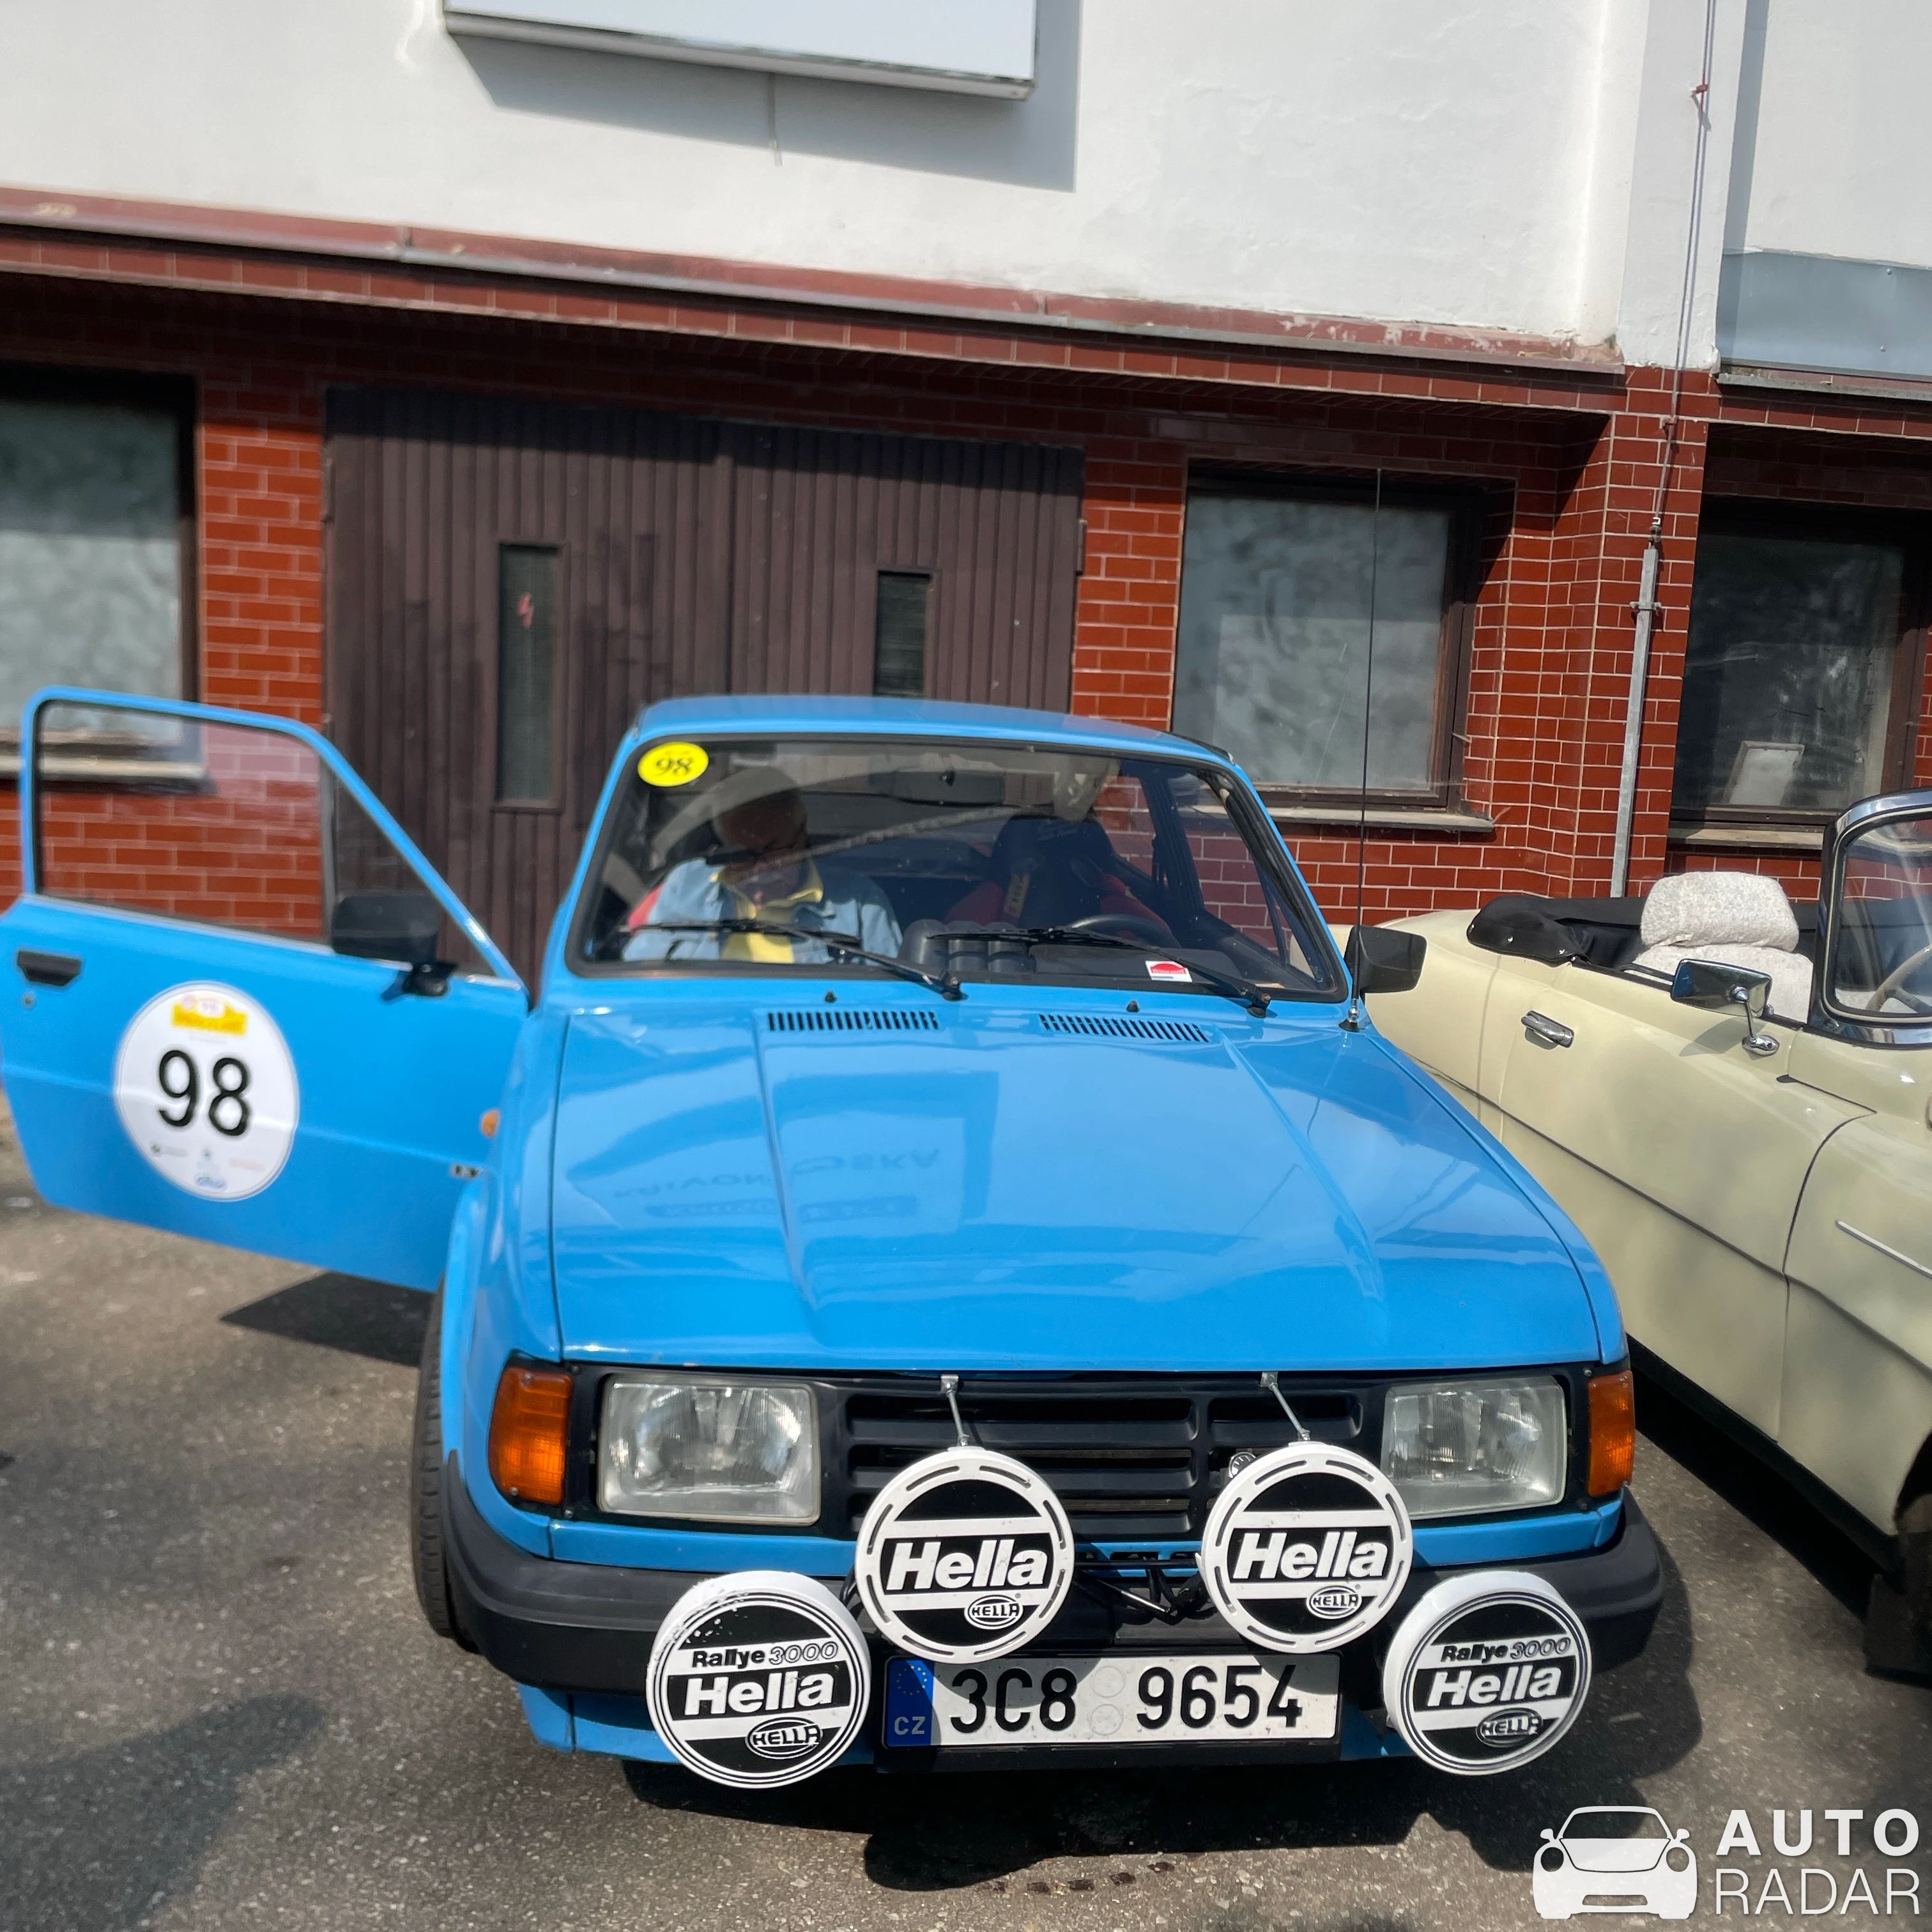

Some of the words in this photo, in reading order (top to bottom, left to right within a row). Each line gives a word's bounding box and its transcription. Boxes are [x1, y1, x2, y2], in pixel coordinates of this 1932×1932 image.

[653, 757, 693, 777] 98
[158, 1049, 251, 1137] 98
[886, 1538, 1048, 1590] Hella
[1232, 1531, 1388, 1579] Hella
[971, 1603, 1020, 1616] HELLA
[1312, 1594, 1359, 1607] HELLA
[692, 1648, 765, 1669] Rallye
[769, 1641, 838, 1665] 3000
[1441, 1643, 1509, 1664] Rallye
[1510, 1637, 1572, 1660] 3000
[684, 1671, 834, 1715] Hella
[950, 1667, 1077, 1733] 3C8
[1136, 1664, 1303, 1729] 9654
[1427, 1665, 1561, 1706] Hella
[752, 1724, 820, 1745] HELLA
[894, 1717, 925, 1735] CZ
[1482, 1716, 1540, 1736] HELLA
